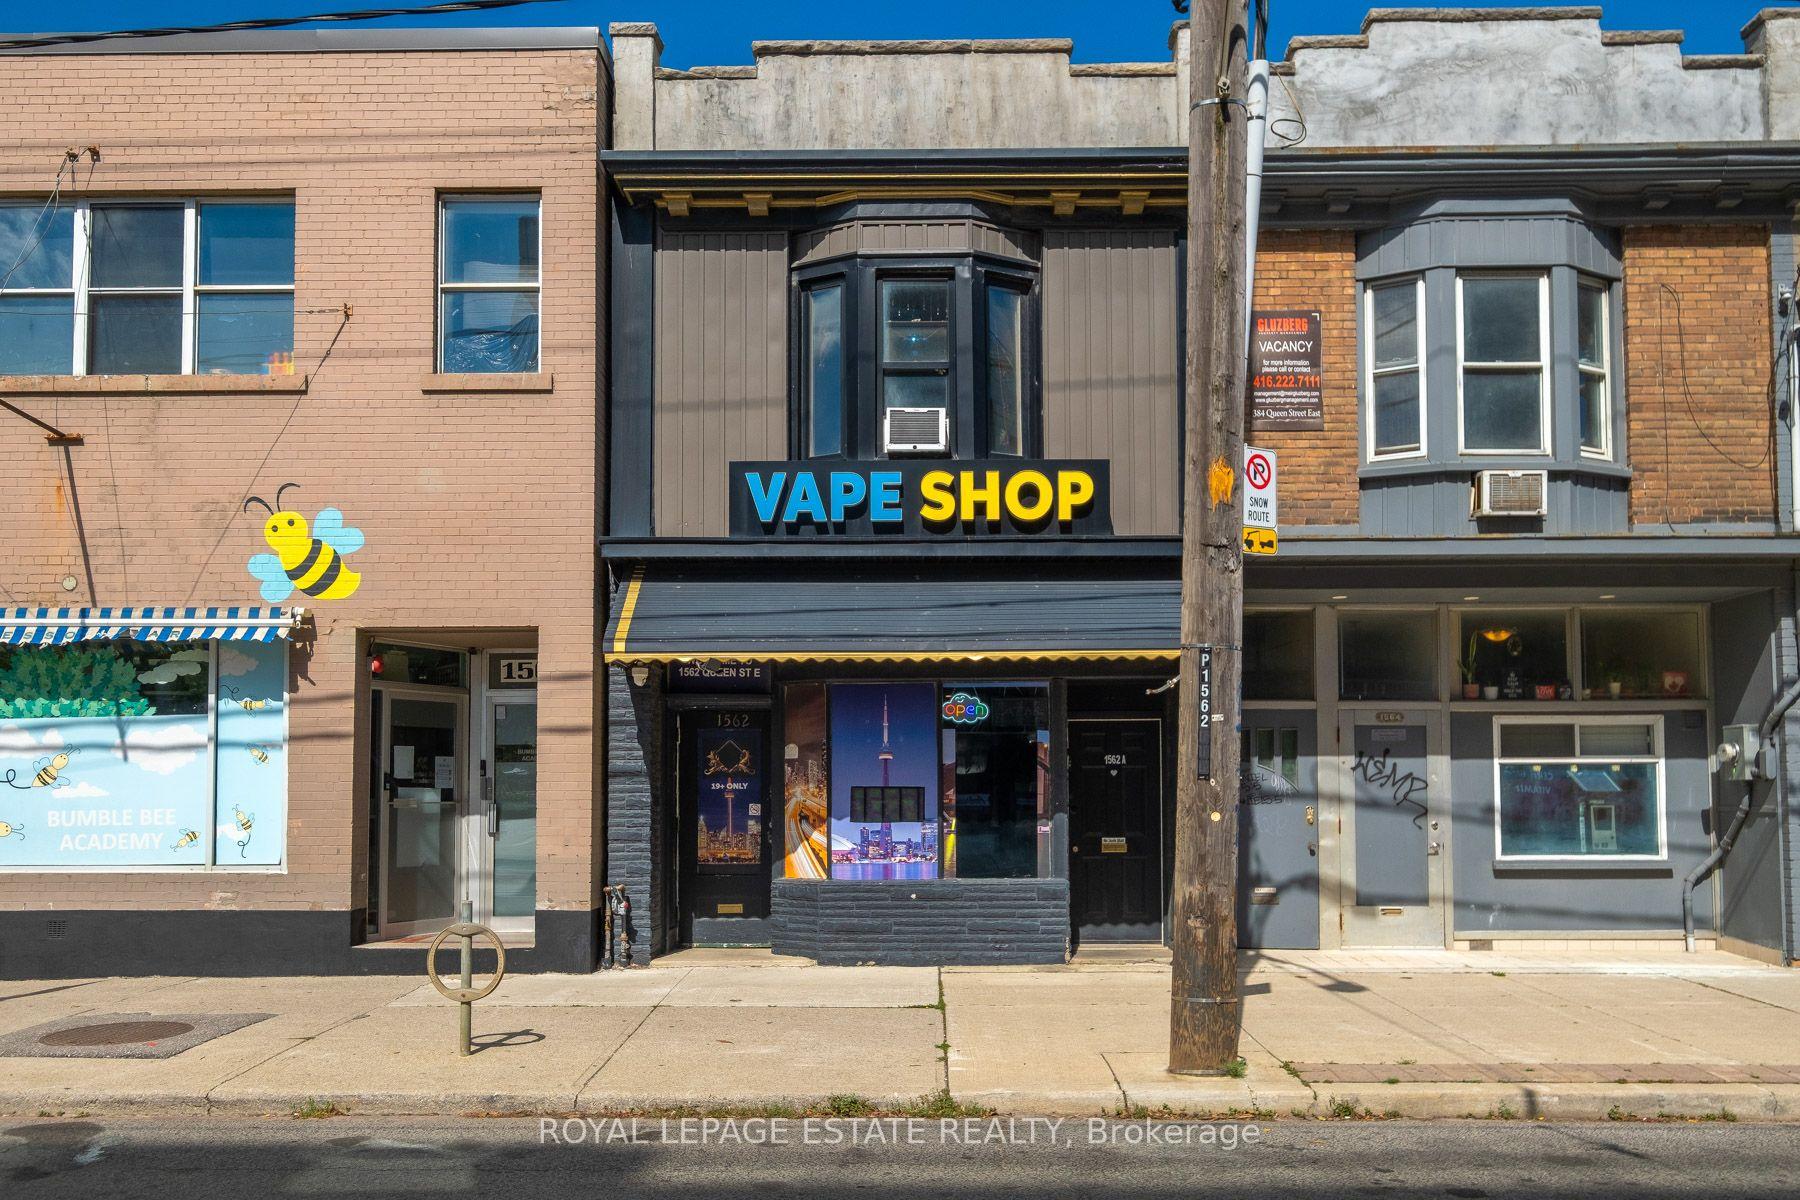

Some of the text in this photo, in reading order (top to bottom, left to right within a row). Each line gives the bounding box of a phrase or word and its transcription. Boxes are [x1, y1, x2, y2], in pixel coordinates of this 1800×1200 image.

[1257, 318, 1308, 331] GLUZBERG
[1258, 340, 1314, 352] VACANCY
[1253, 375, 1320, 388] 416.222.7111
[1253, 409, 1321, 418] 384 Queen Street East
[745, 470, 1095, 522] VAPE SHOP
[1249, 497, 1269, 508] SNOW
[1248, 510, 1270, 522] ROUTE
[502, 662, 538, 680] 15
[678, 667, 700, 677] 1562
[739, 668, 752, 677] ST
[754, 669, 761, 678] E
[717, 714, 750, 727] 1562
[1104, 754, 1127, 764] 1562 A
[47, 808, 177, 828] BUMBLE BEE
[60, 832, 164, 851] ACADEMY
